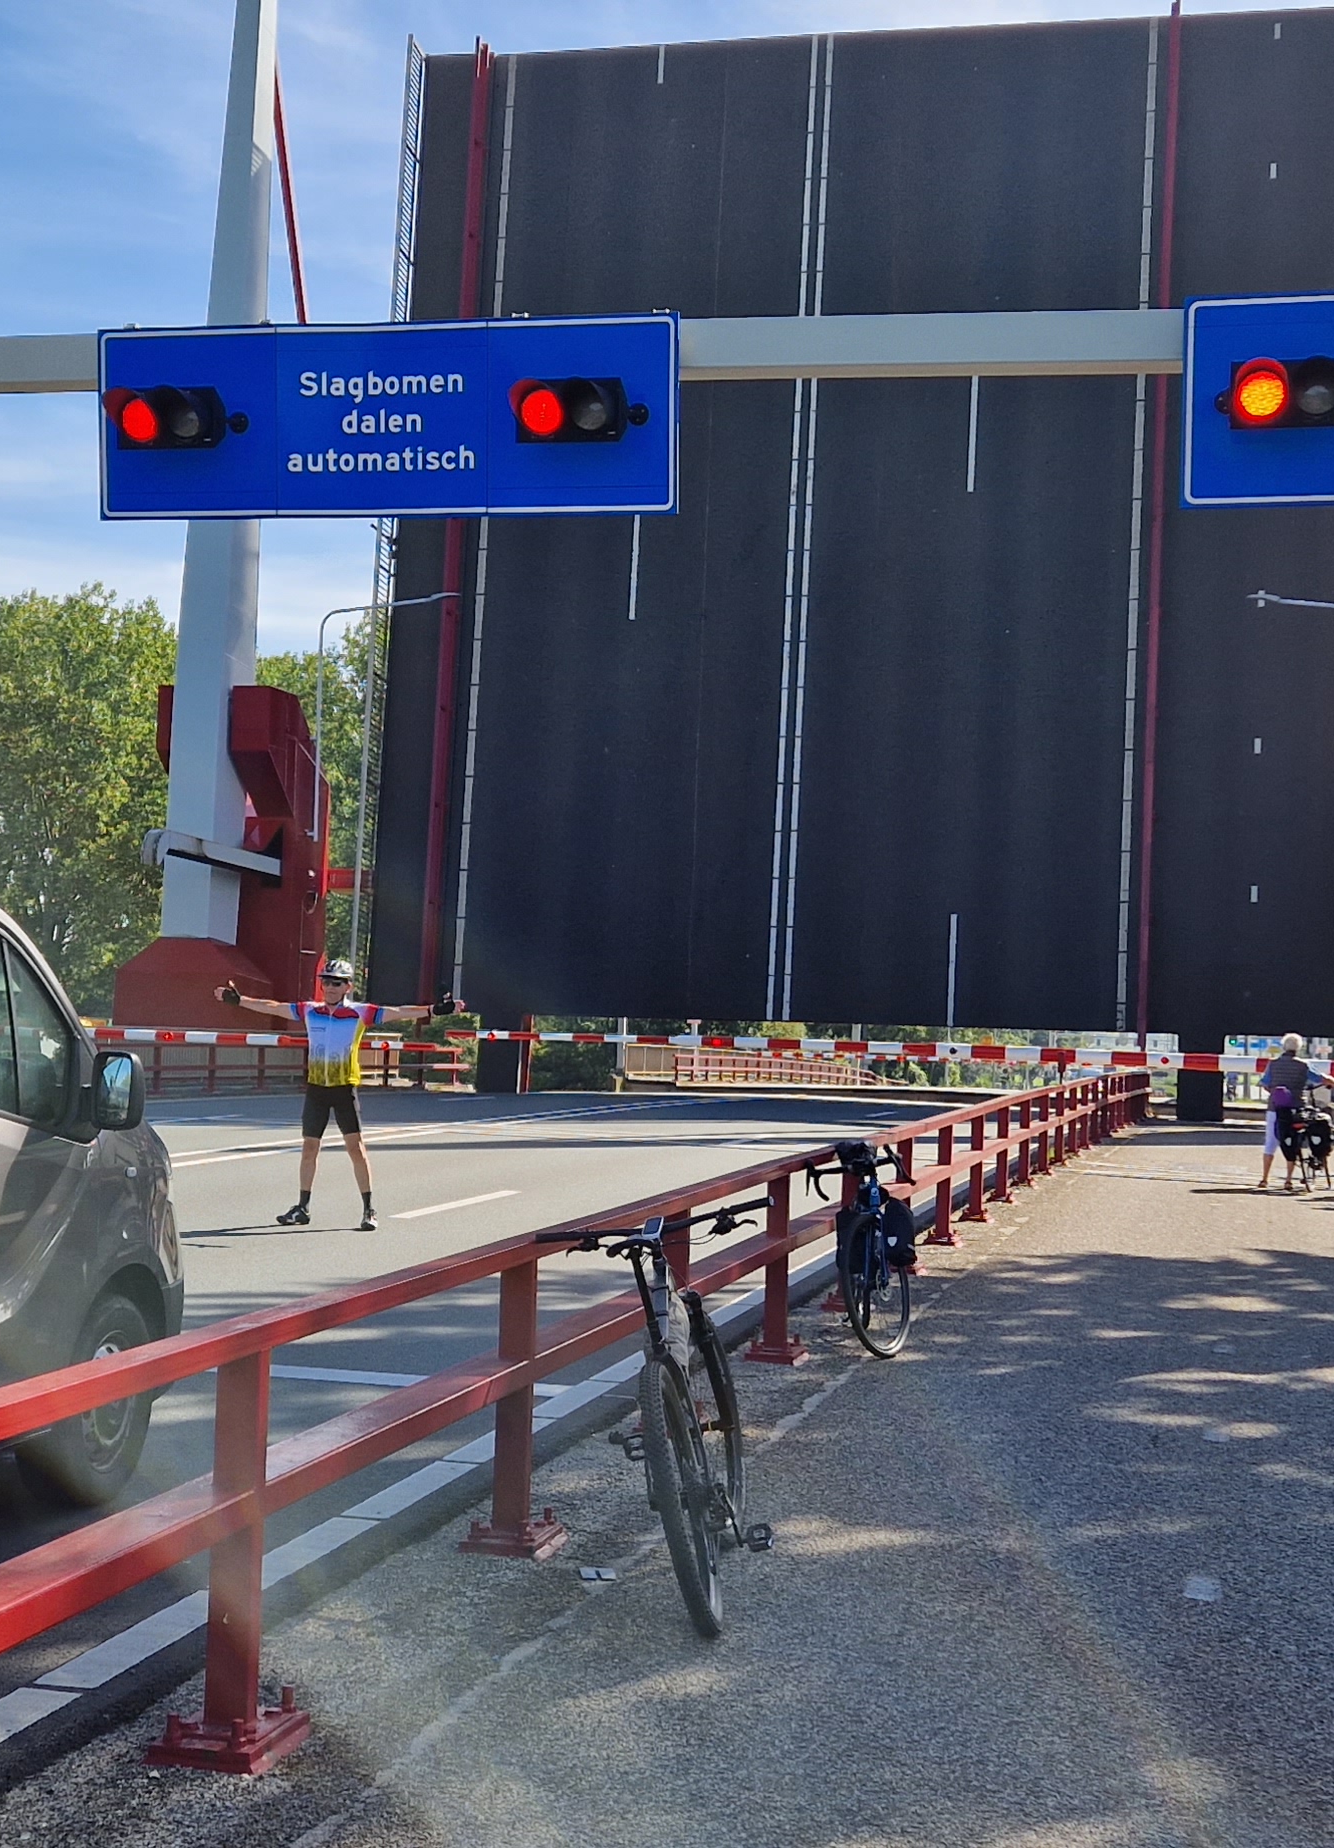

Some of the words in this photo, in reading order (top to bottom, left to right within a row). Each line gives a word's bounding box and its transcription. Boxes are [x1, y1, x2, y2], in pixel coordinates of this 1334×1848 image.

[299, 371, 464, 403] Slagbomen
[341, 408, 422, 434] dalen
[287, 445, 475, 473] automatisch
